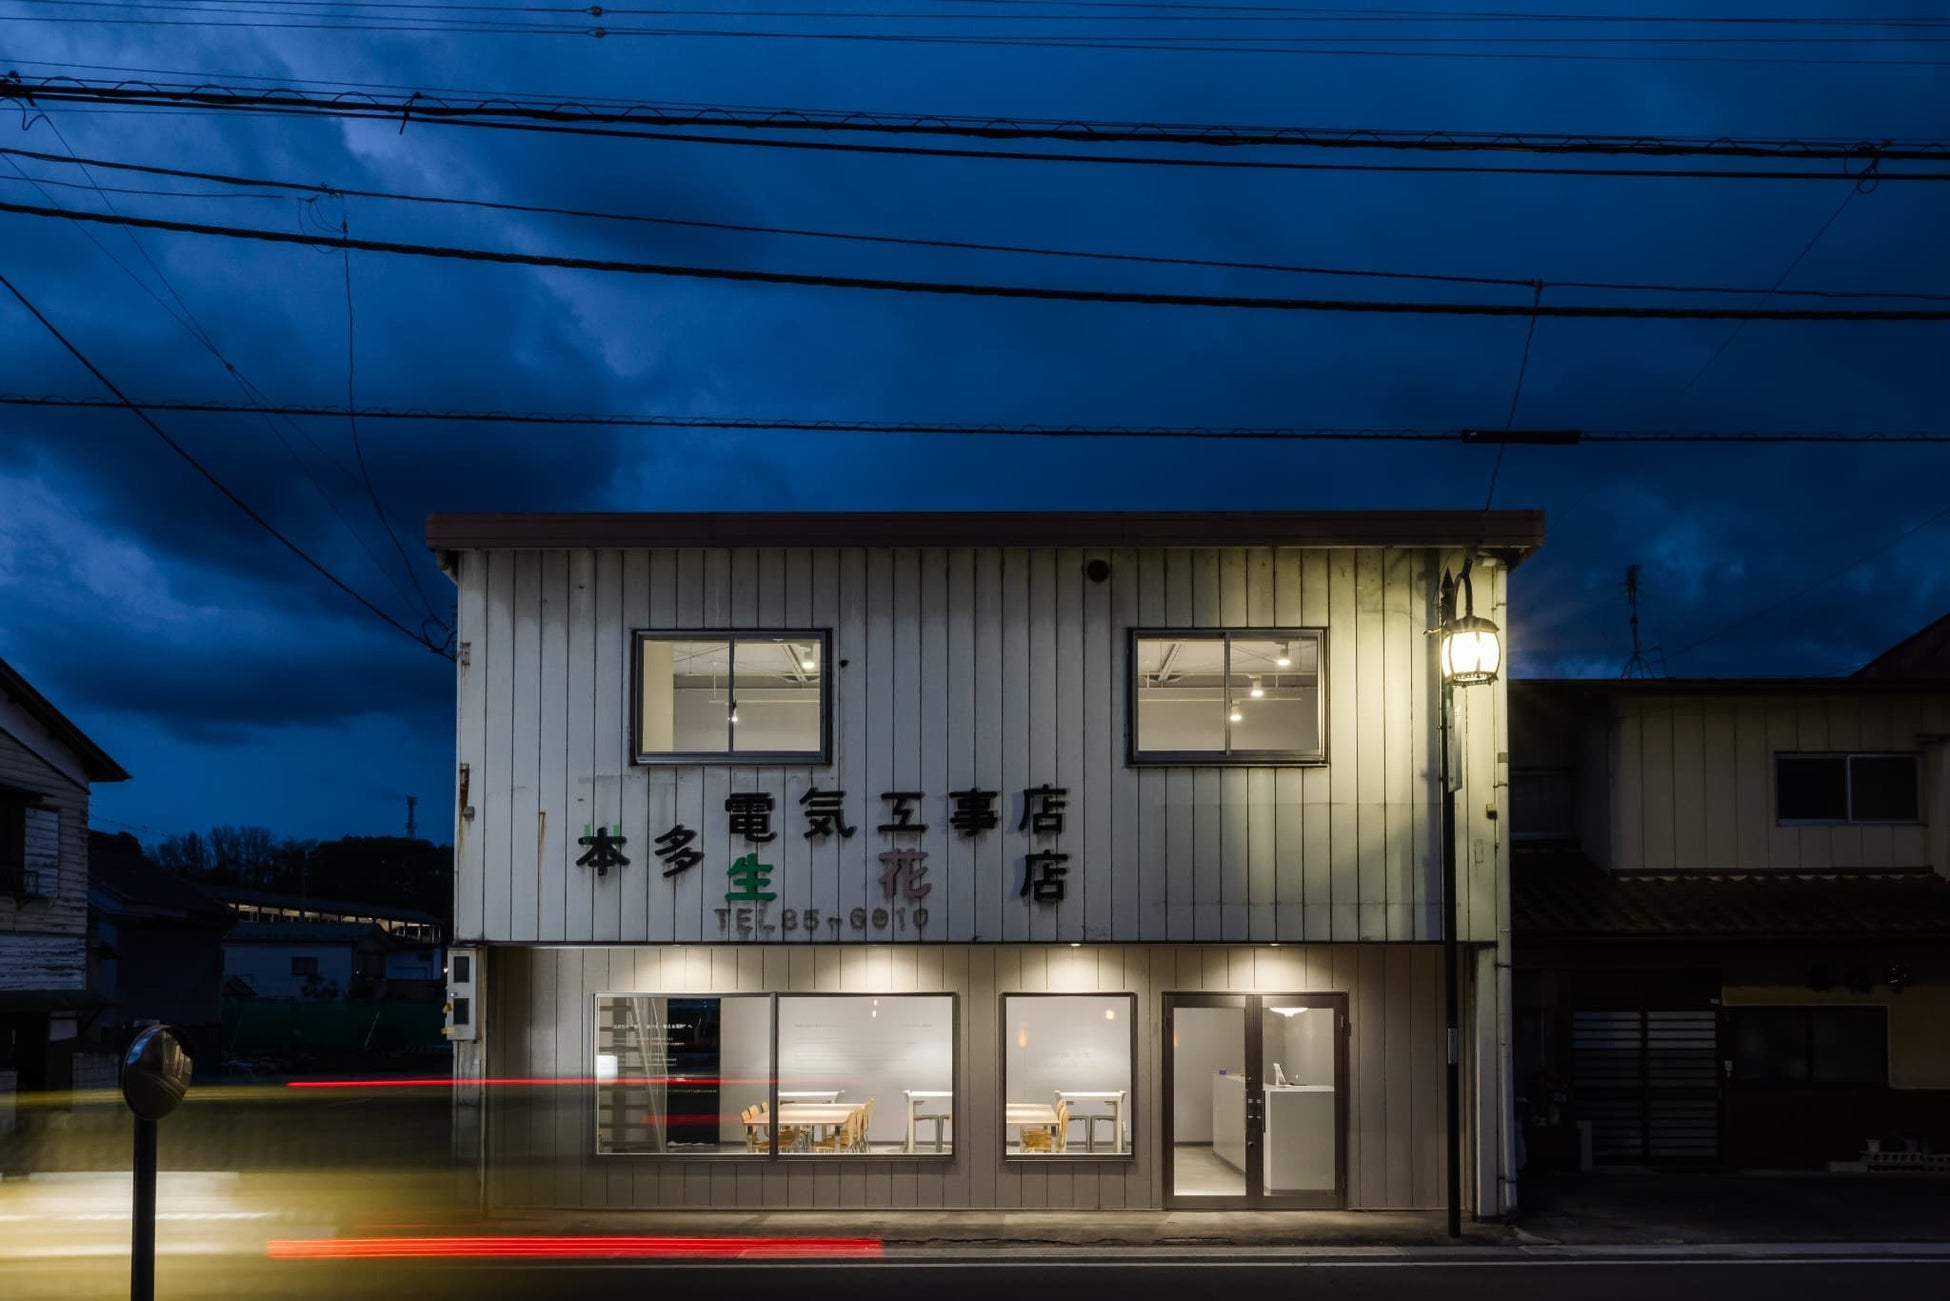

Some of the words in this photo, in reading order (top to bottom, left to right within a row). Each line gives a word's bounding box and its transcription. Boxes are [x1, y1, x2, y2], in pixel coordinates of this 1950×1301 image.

[724, 784, 1069, 842] 電気工事店
[576, 824, 705, 877] 本多
[724, 848, 1069, 903] 生花店
